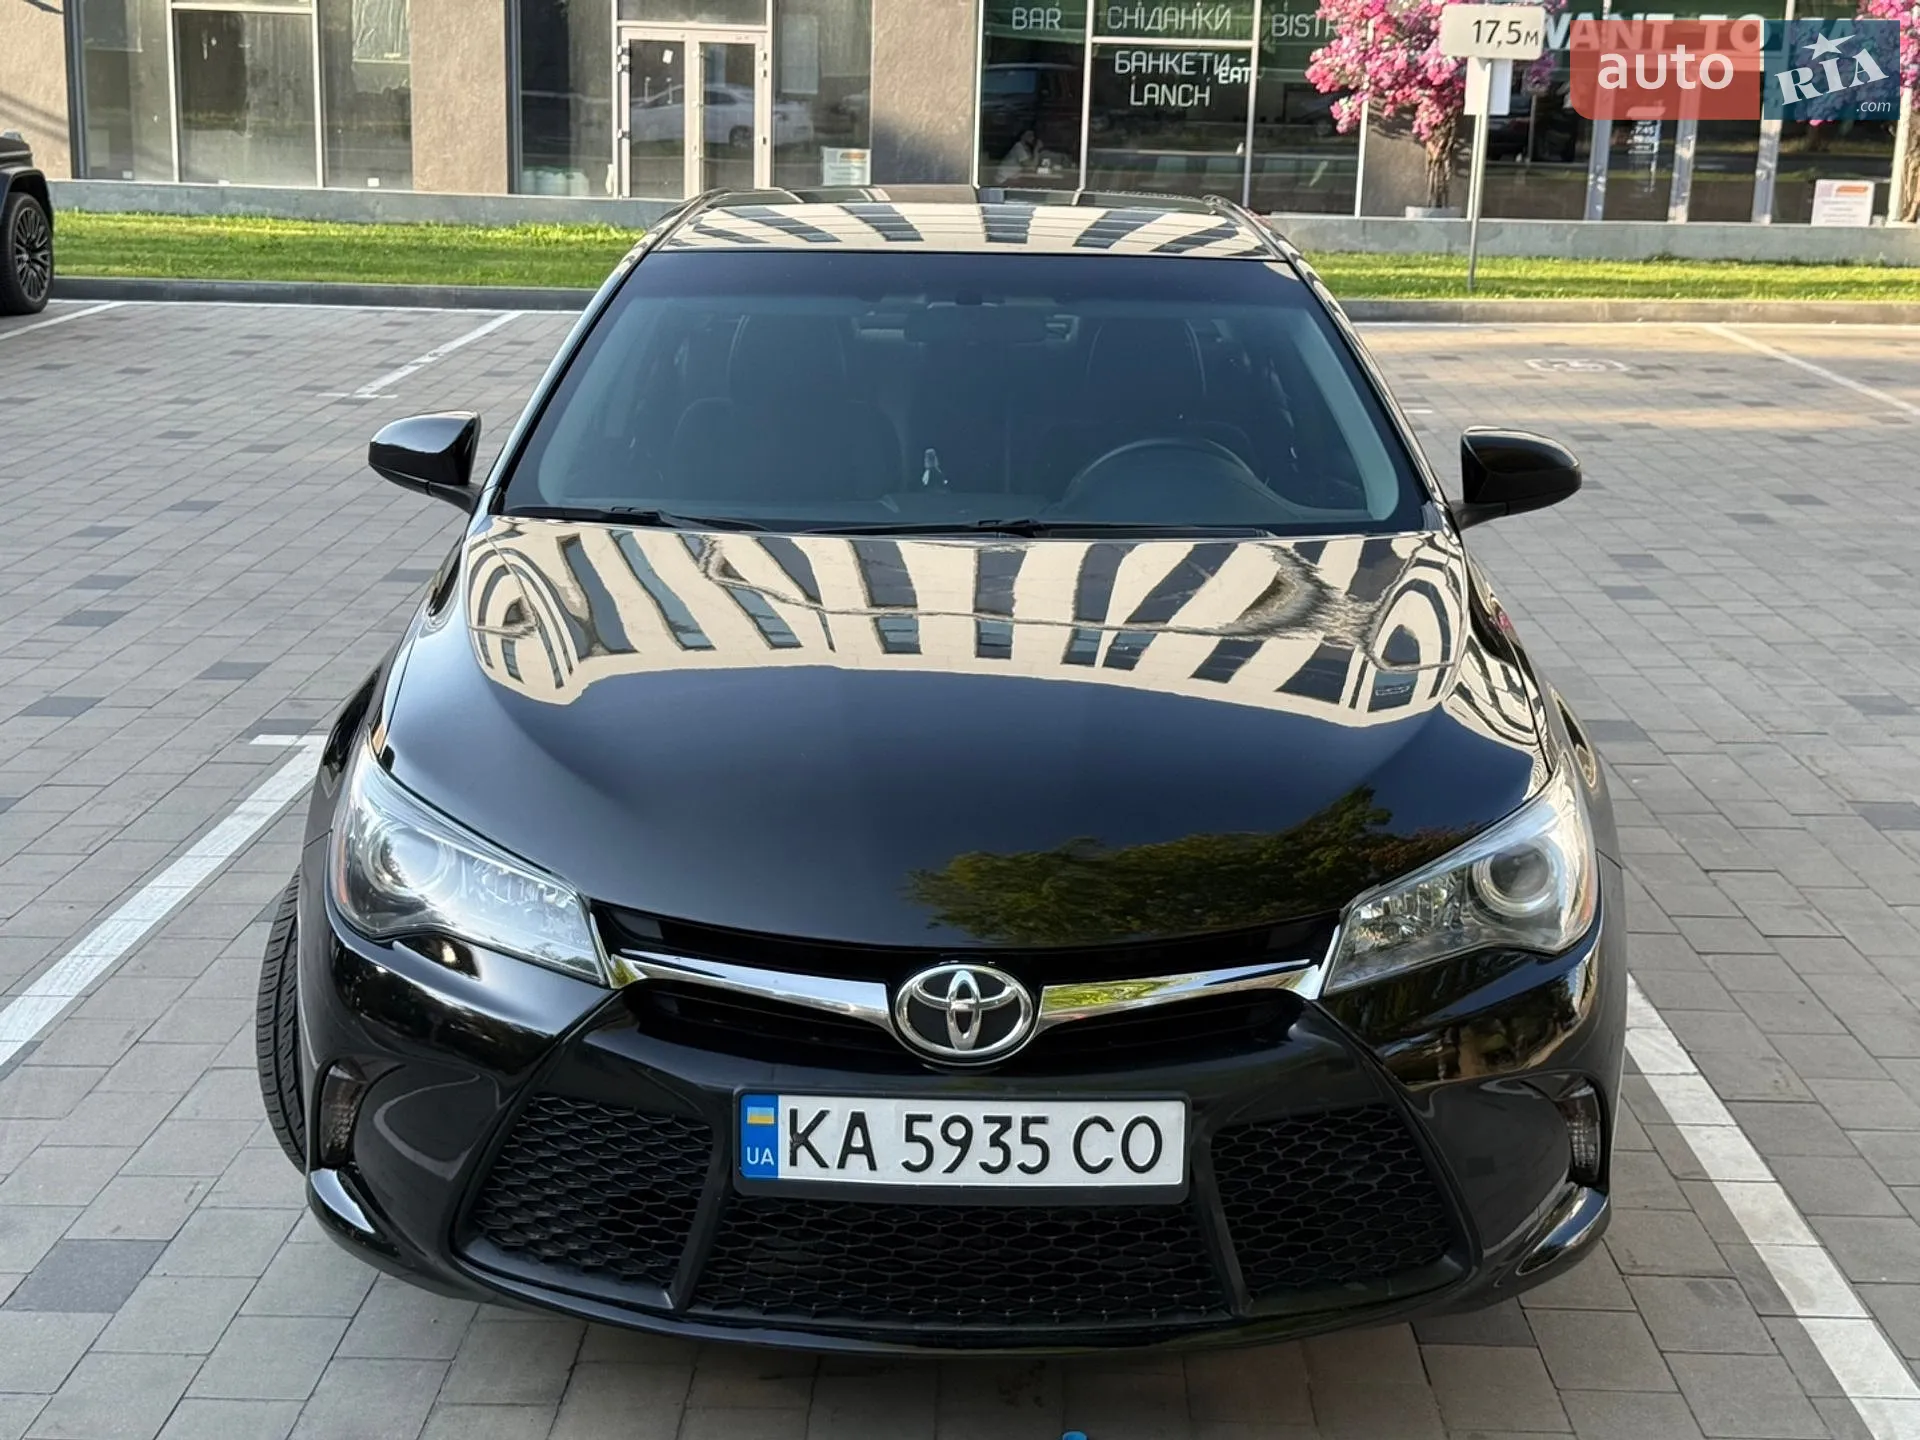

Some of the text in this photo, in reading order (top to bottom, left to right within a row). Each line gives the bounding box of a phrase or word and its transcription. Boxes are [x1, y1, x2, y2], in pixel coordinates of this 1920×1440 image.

[1012, 7, 1061, 30] BAR
[1107, 6, 1231, 31] СНІДАНКИ
[1115, 51, 1230, 75] БАНКЕТИ
[1130, 83, 1210, 107] LANCH
[788, 1108, 1163, 1175] KA 5935 CO
[747, 1148, 775, 1167] UA
